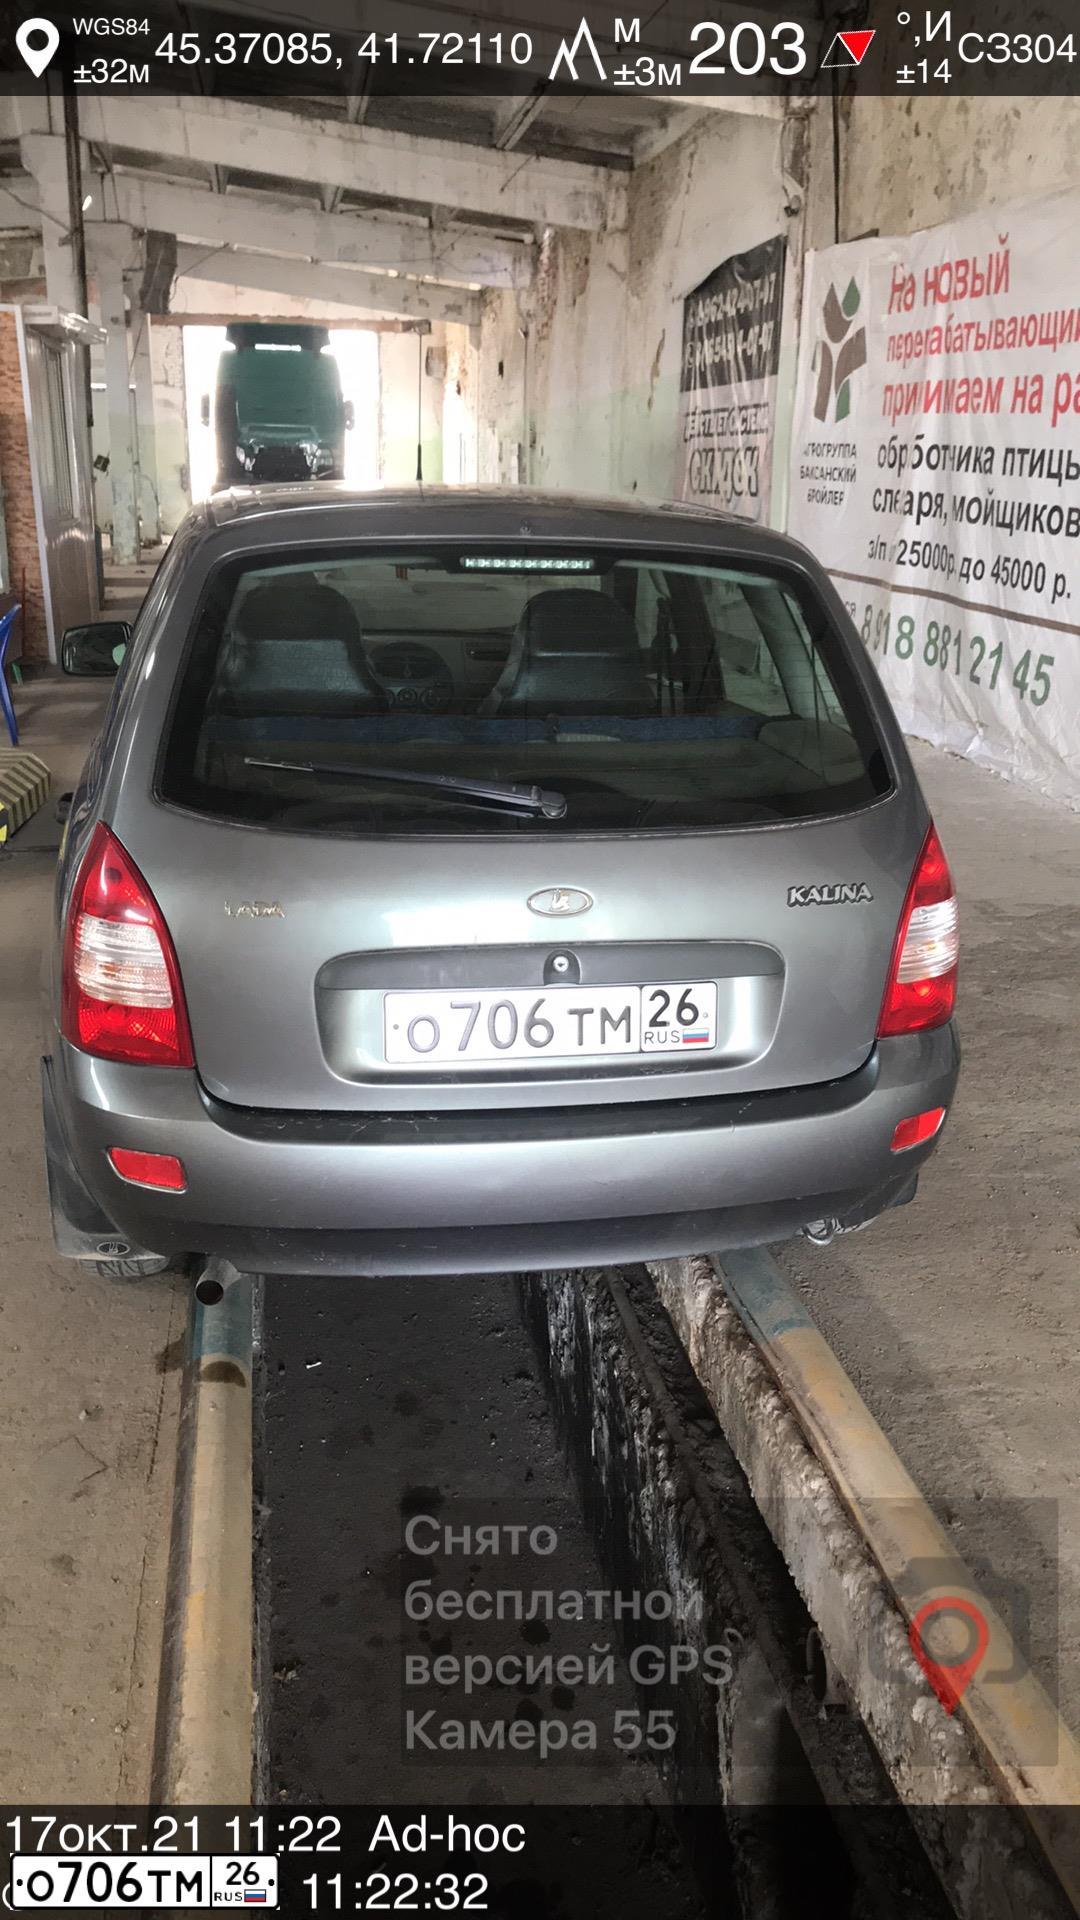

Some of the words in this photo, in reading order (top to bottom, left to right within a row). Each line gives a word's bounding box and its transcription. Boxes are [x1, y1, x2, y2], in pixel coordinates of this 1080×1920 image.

[888, 263, 917, 315] На
[923, 231, 1010, 306] новый
[887, 306, 1080, 369] переабатывающи
[1010, 373, 1044, 415] на
[876, 433, 995, 478] обрботчика
[872, 487, 948, 526] слеаря,
[958, 556, 985, 584] до
[991, 554, 1046, 594] 45000
[1051, 572, 1071, 604] р.
[969, 635, 1004, 690] 21
[1012, 648, 1055, 707] 45
[787, 882, 874, 907] KALINA
[647, 988, 699, 1027] 26
[644, 1031, 680, 1044] RUS
